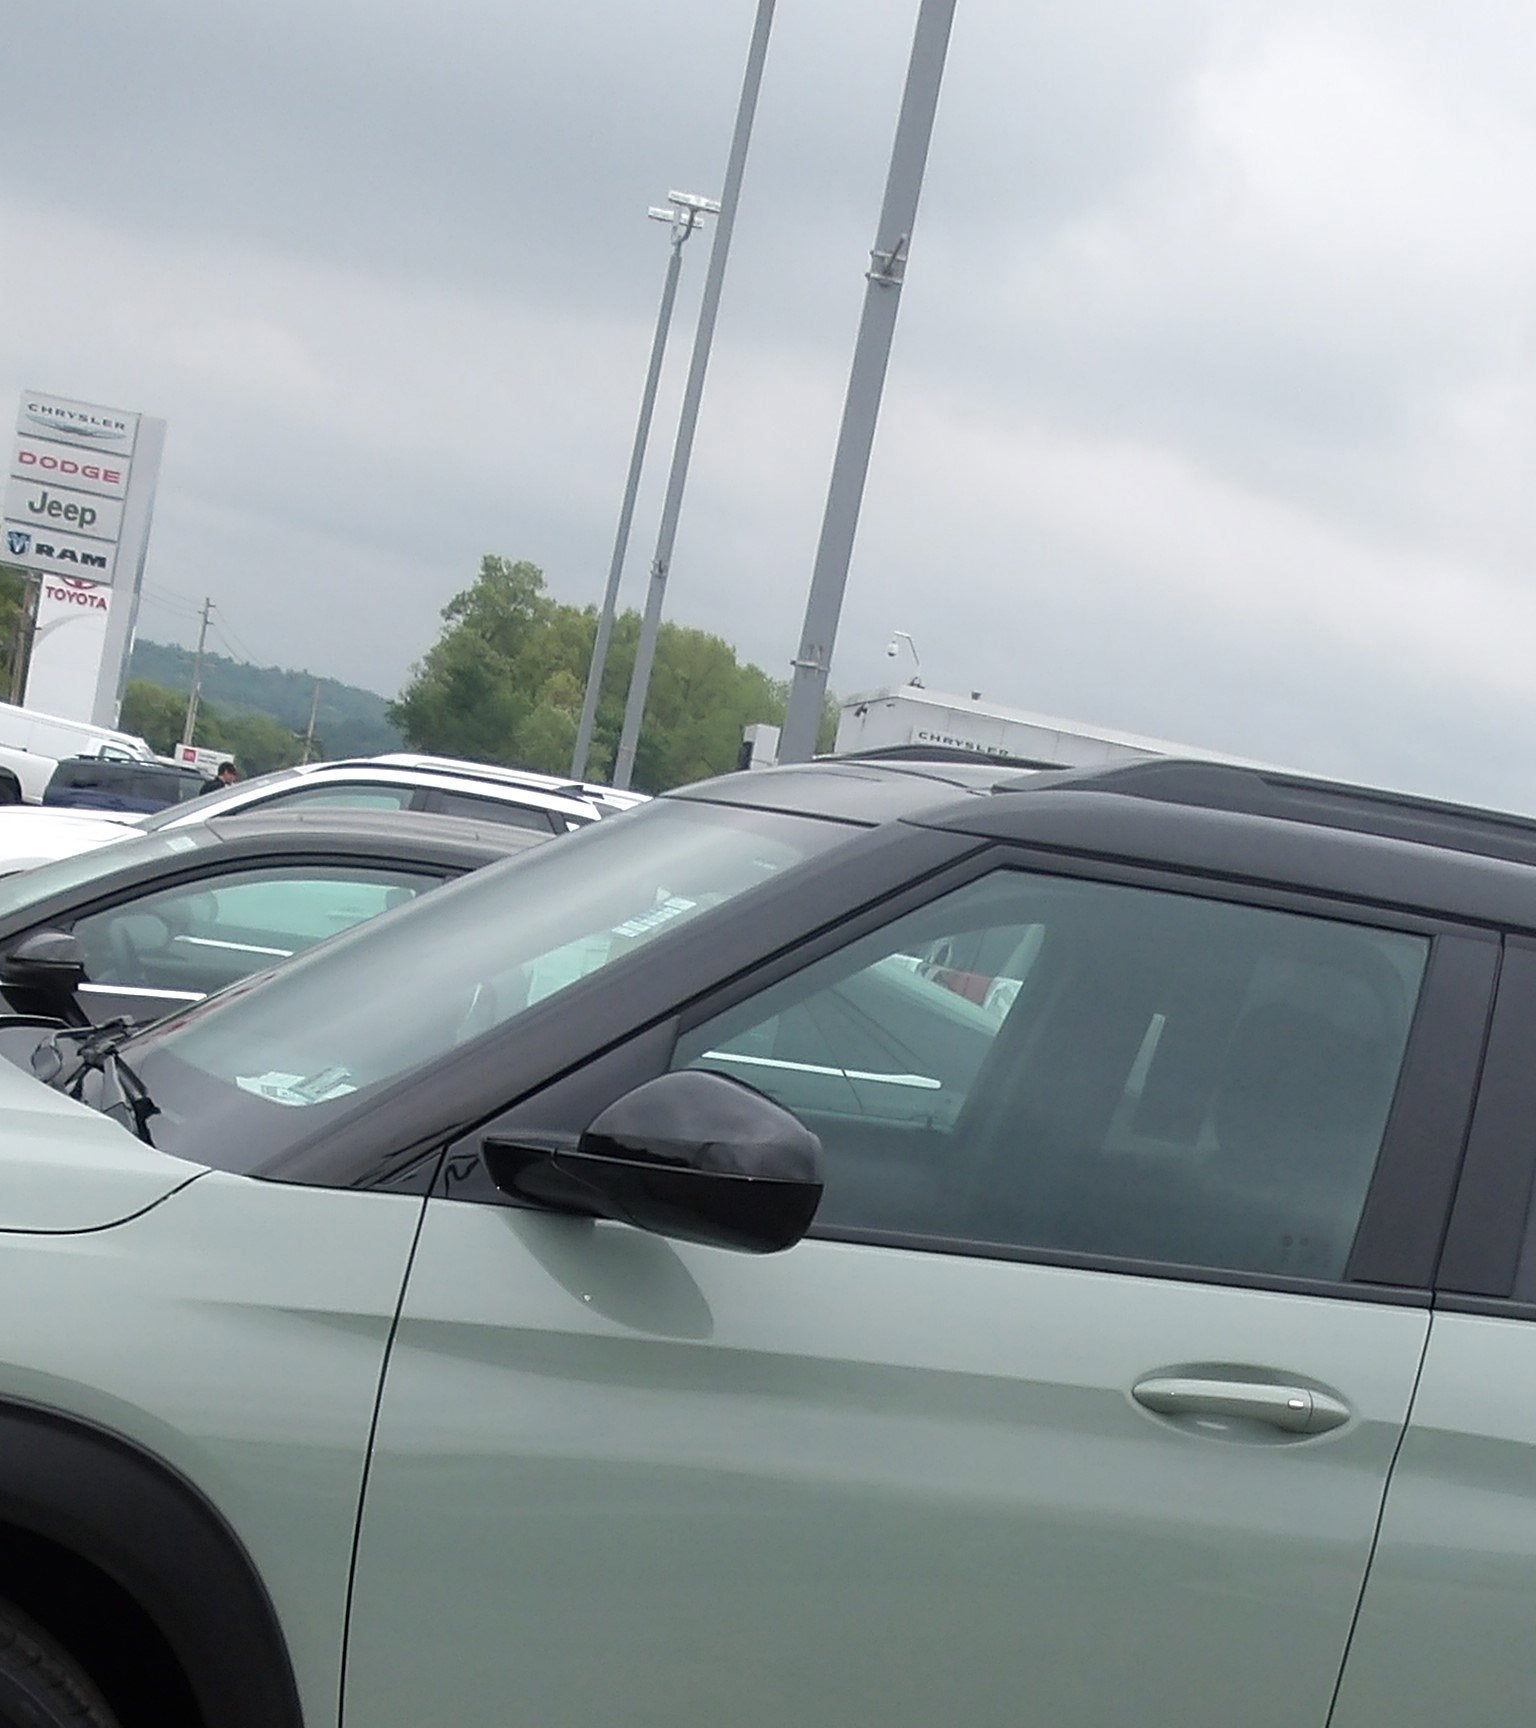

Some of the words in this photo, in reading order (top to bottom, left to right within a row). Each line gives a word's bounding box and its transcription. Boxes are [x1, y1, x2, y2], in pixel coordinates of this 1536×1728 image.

[27, 402, 126, 430] CHRYSLER
[18, 451, 121, 484] DODGE
[28, 491, 97, 528] Jeep
[35, 543, 107, 569] RAM
[45, 586, 108, 610] TOYOTA
